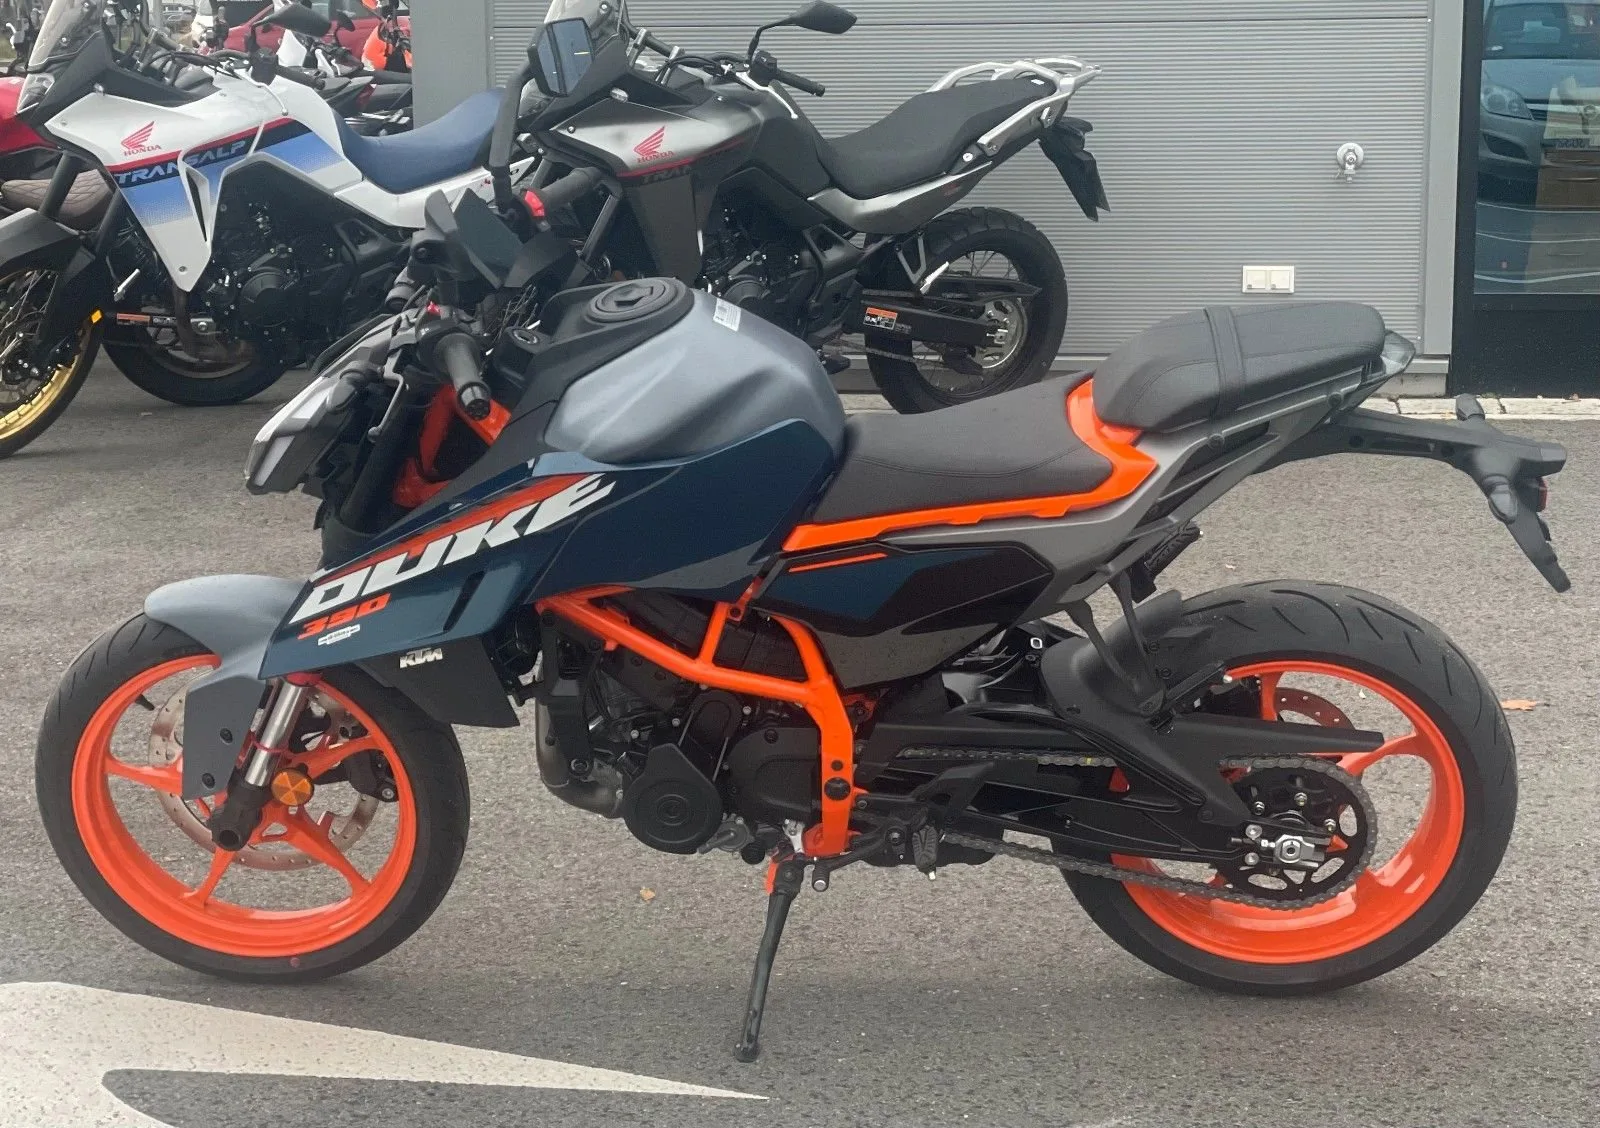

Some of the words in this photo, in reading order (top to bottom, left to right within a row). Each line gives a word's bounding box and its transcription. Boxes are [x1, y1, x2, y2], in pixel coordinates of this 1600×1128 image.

[115, 141, 245, 184] TRANSALP
[123, 144, 162, 156] HONDA
[638, 151, 674, 162] HONDA
[288, 473, 616, 624] DUKE
[297, 593, 391, 640] 390
[400, 648, 443, 668] KTM
